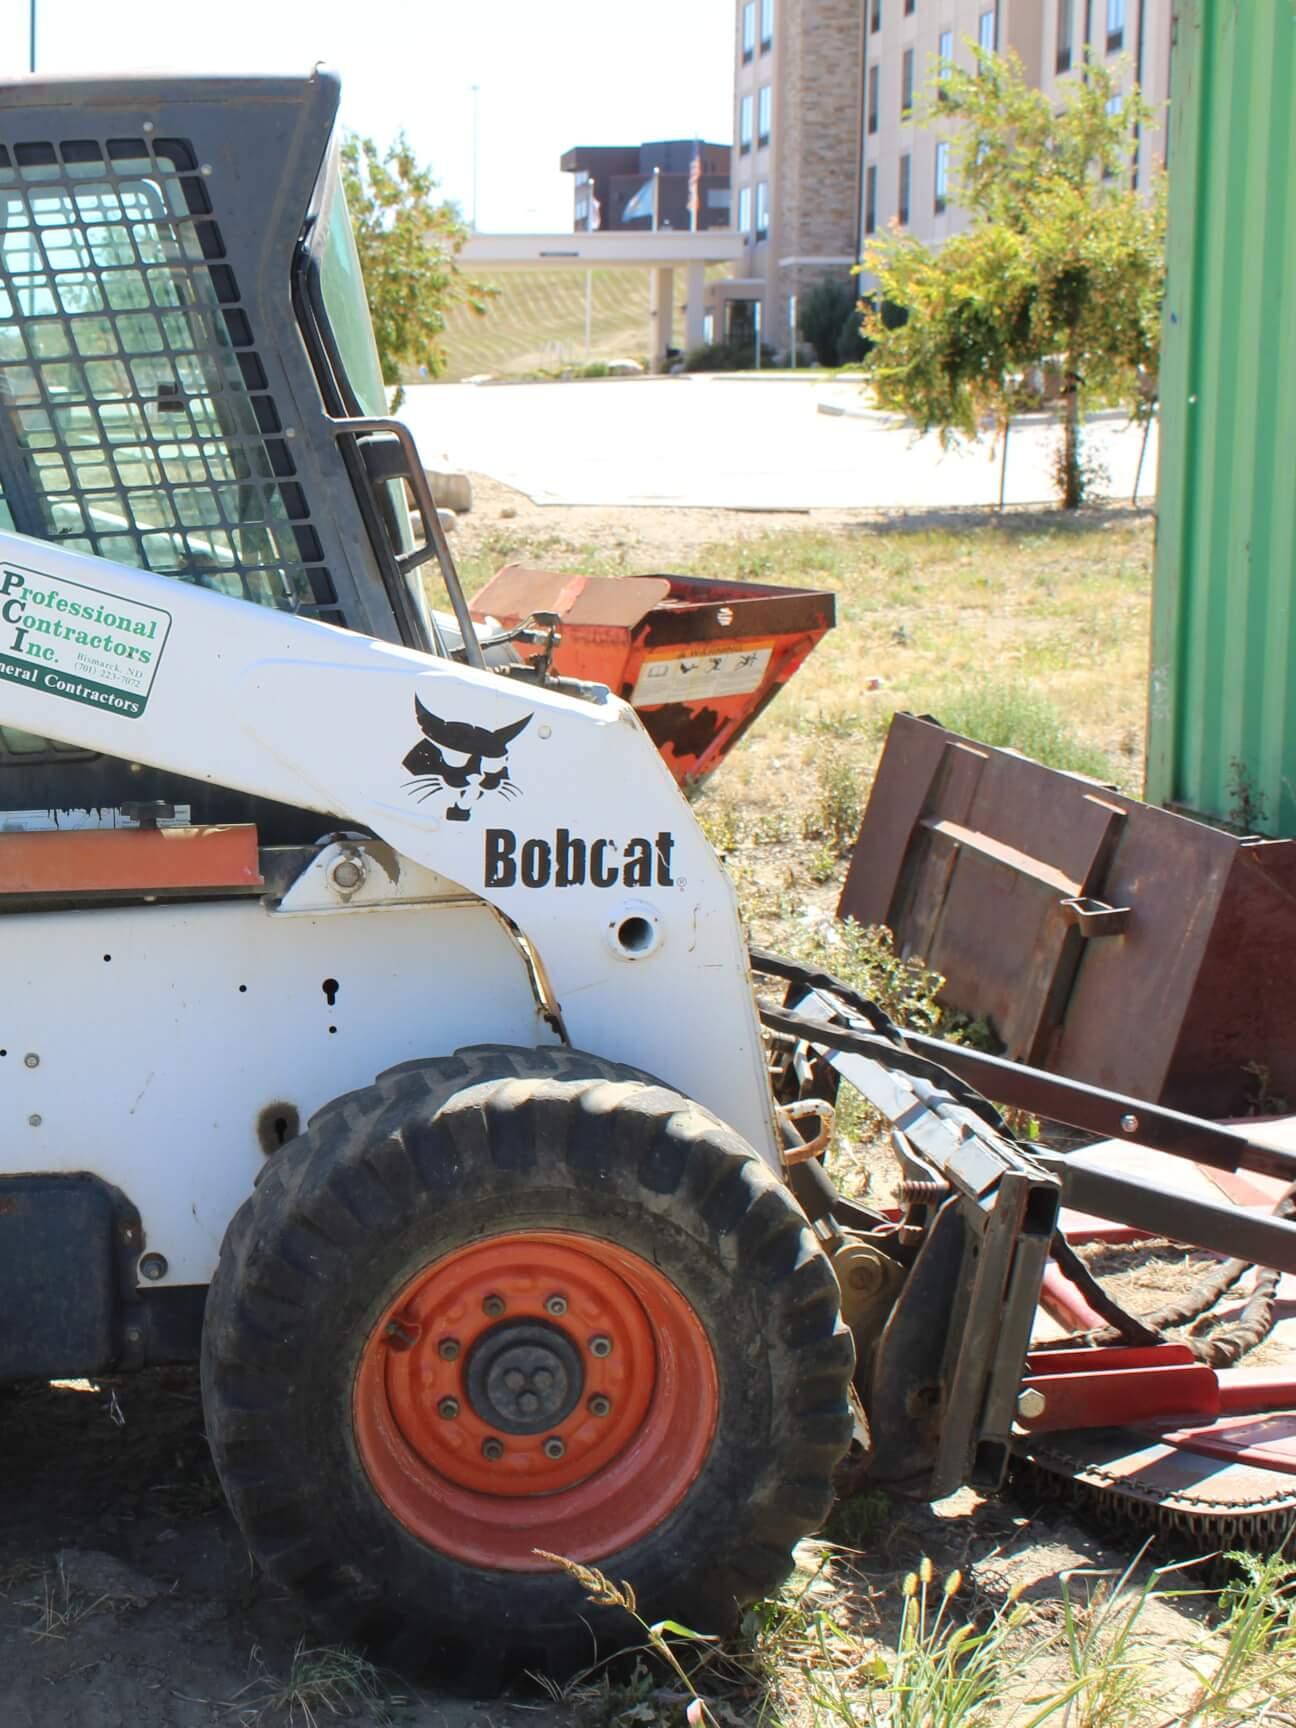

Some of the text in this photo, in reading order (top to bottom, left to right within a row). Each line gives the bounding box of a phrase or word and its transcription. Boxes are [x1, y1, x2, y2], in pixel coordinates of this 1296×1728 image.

[2, 599, 152, 664] Contractors
[10, 627, 59, 663] Inc.
[44, 673, 140, 713] Contractors
[484, 828, 675, 889] Bobcat
